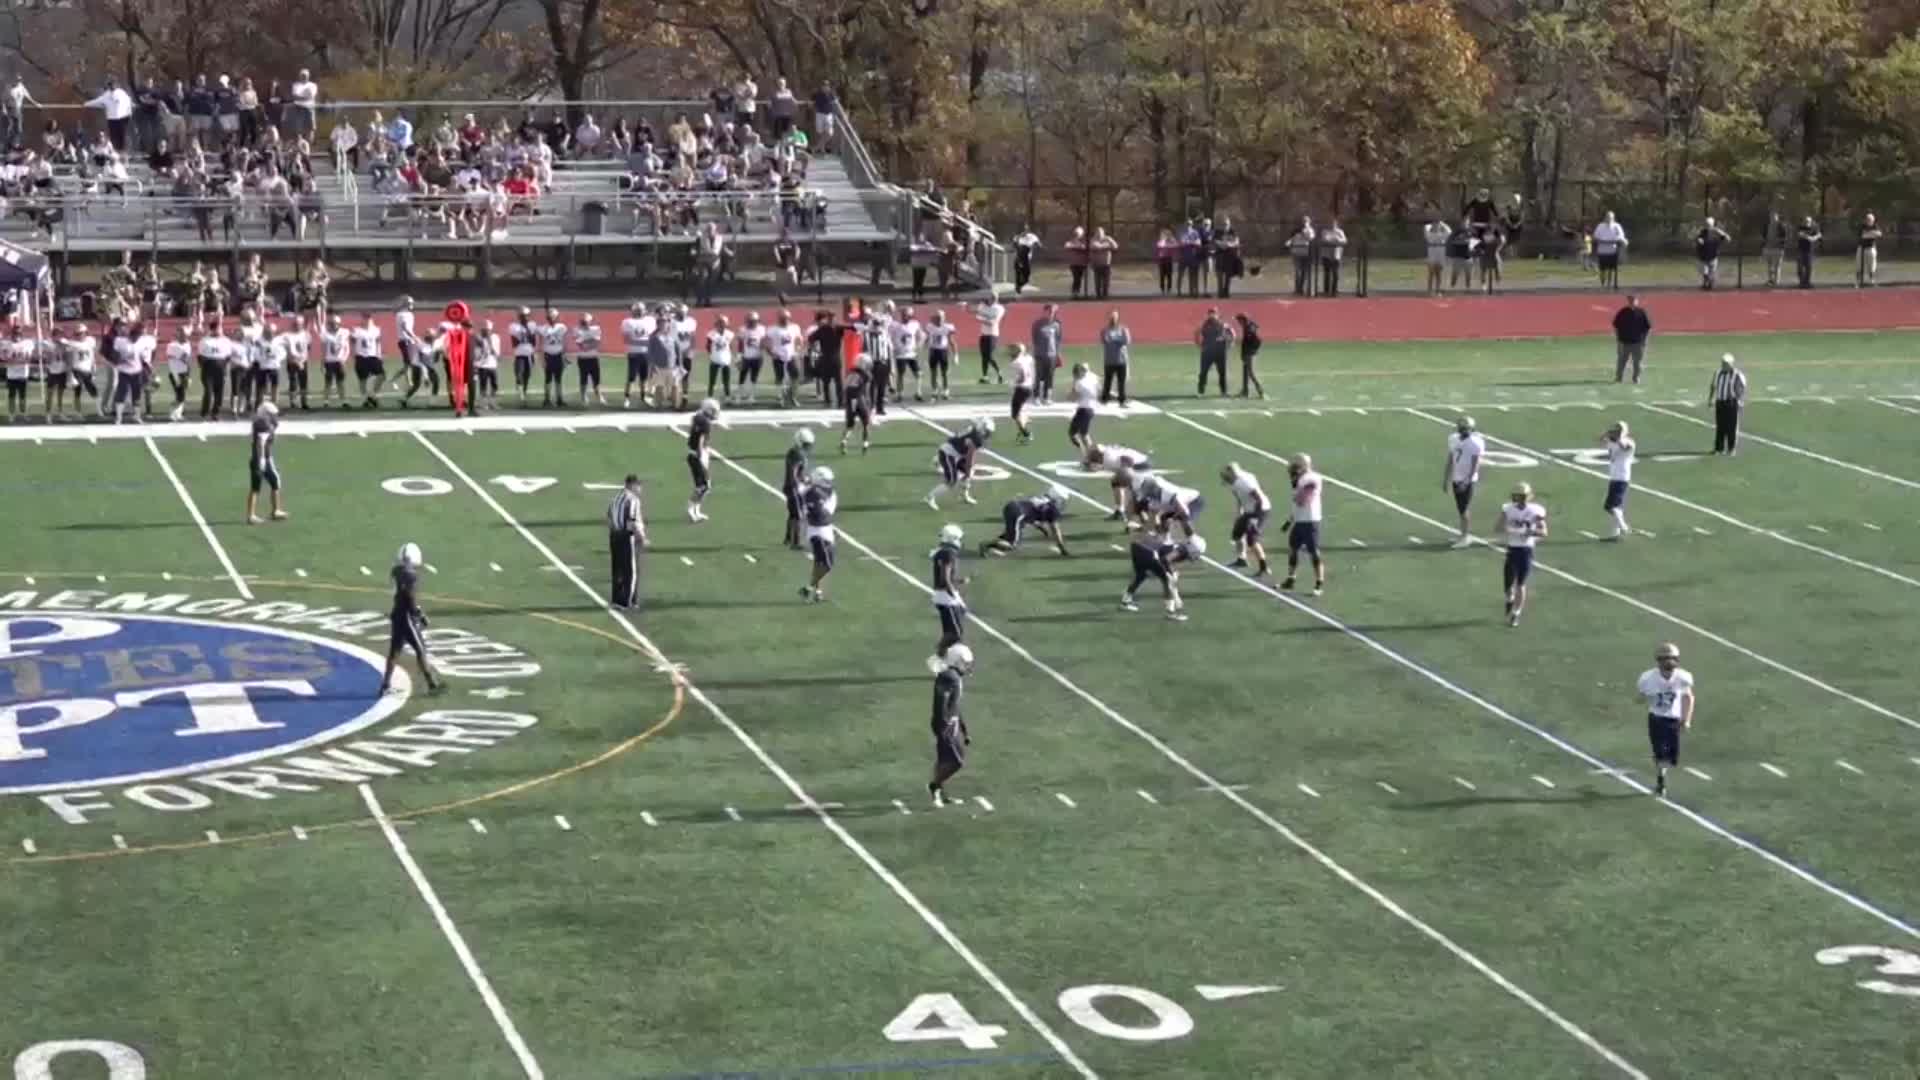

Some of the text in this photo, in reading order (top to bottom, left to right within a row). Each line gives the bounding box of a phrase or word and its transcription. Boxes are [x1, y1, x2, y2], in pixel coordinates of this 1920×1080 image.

[0, 589, 393, 639] EMORIA
[38, 709, 540, 824] FORWARD
[882, 983, 1194, 1049] 40
